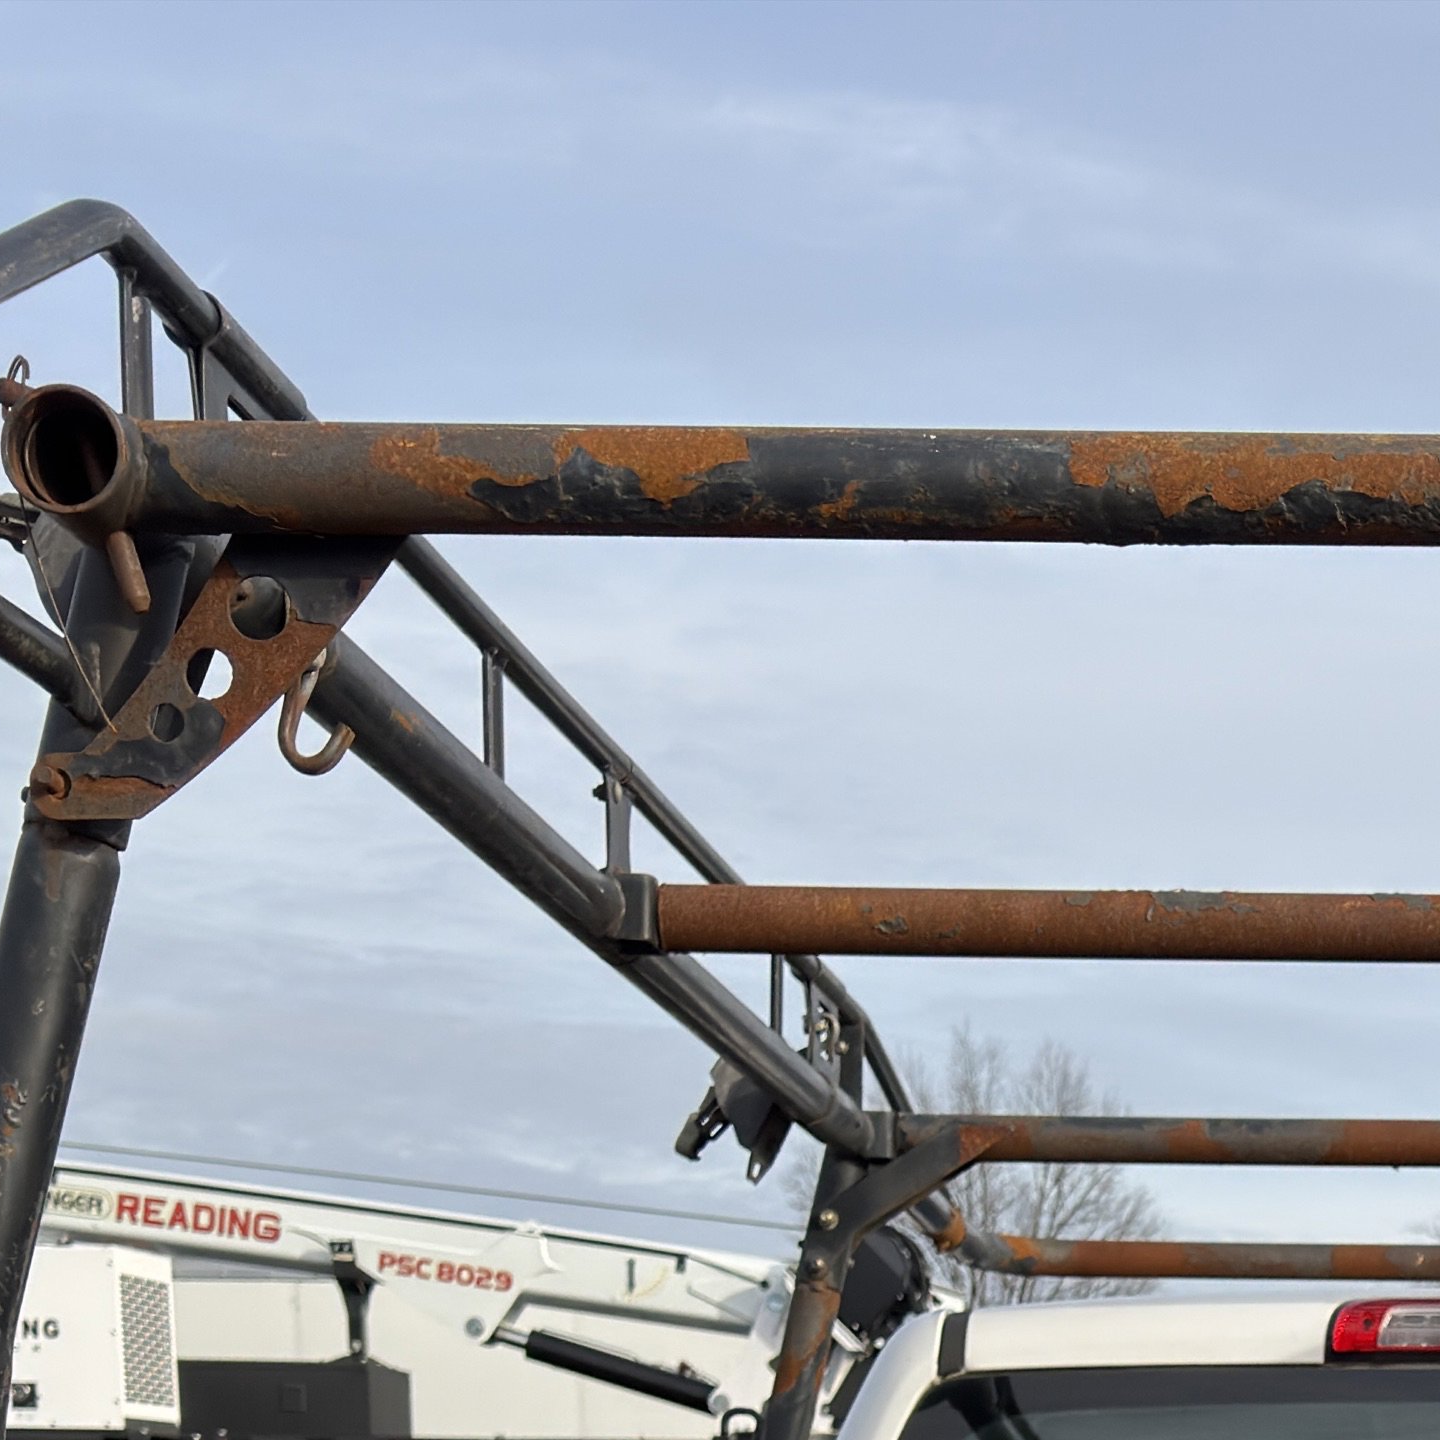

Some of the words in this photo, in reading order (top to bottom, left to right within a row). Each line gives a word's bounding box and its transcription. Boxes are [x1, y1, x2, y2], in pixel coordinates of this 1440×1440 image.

[115, 1193, 282, 1242] READING
[377, 1252, 433, 1280] PSC
[436, 1261, 514, 1293] 8029
